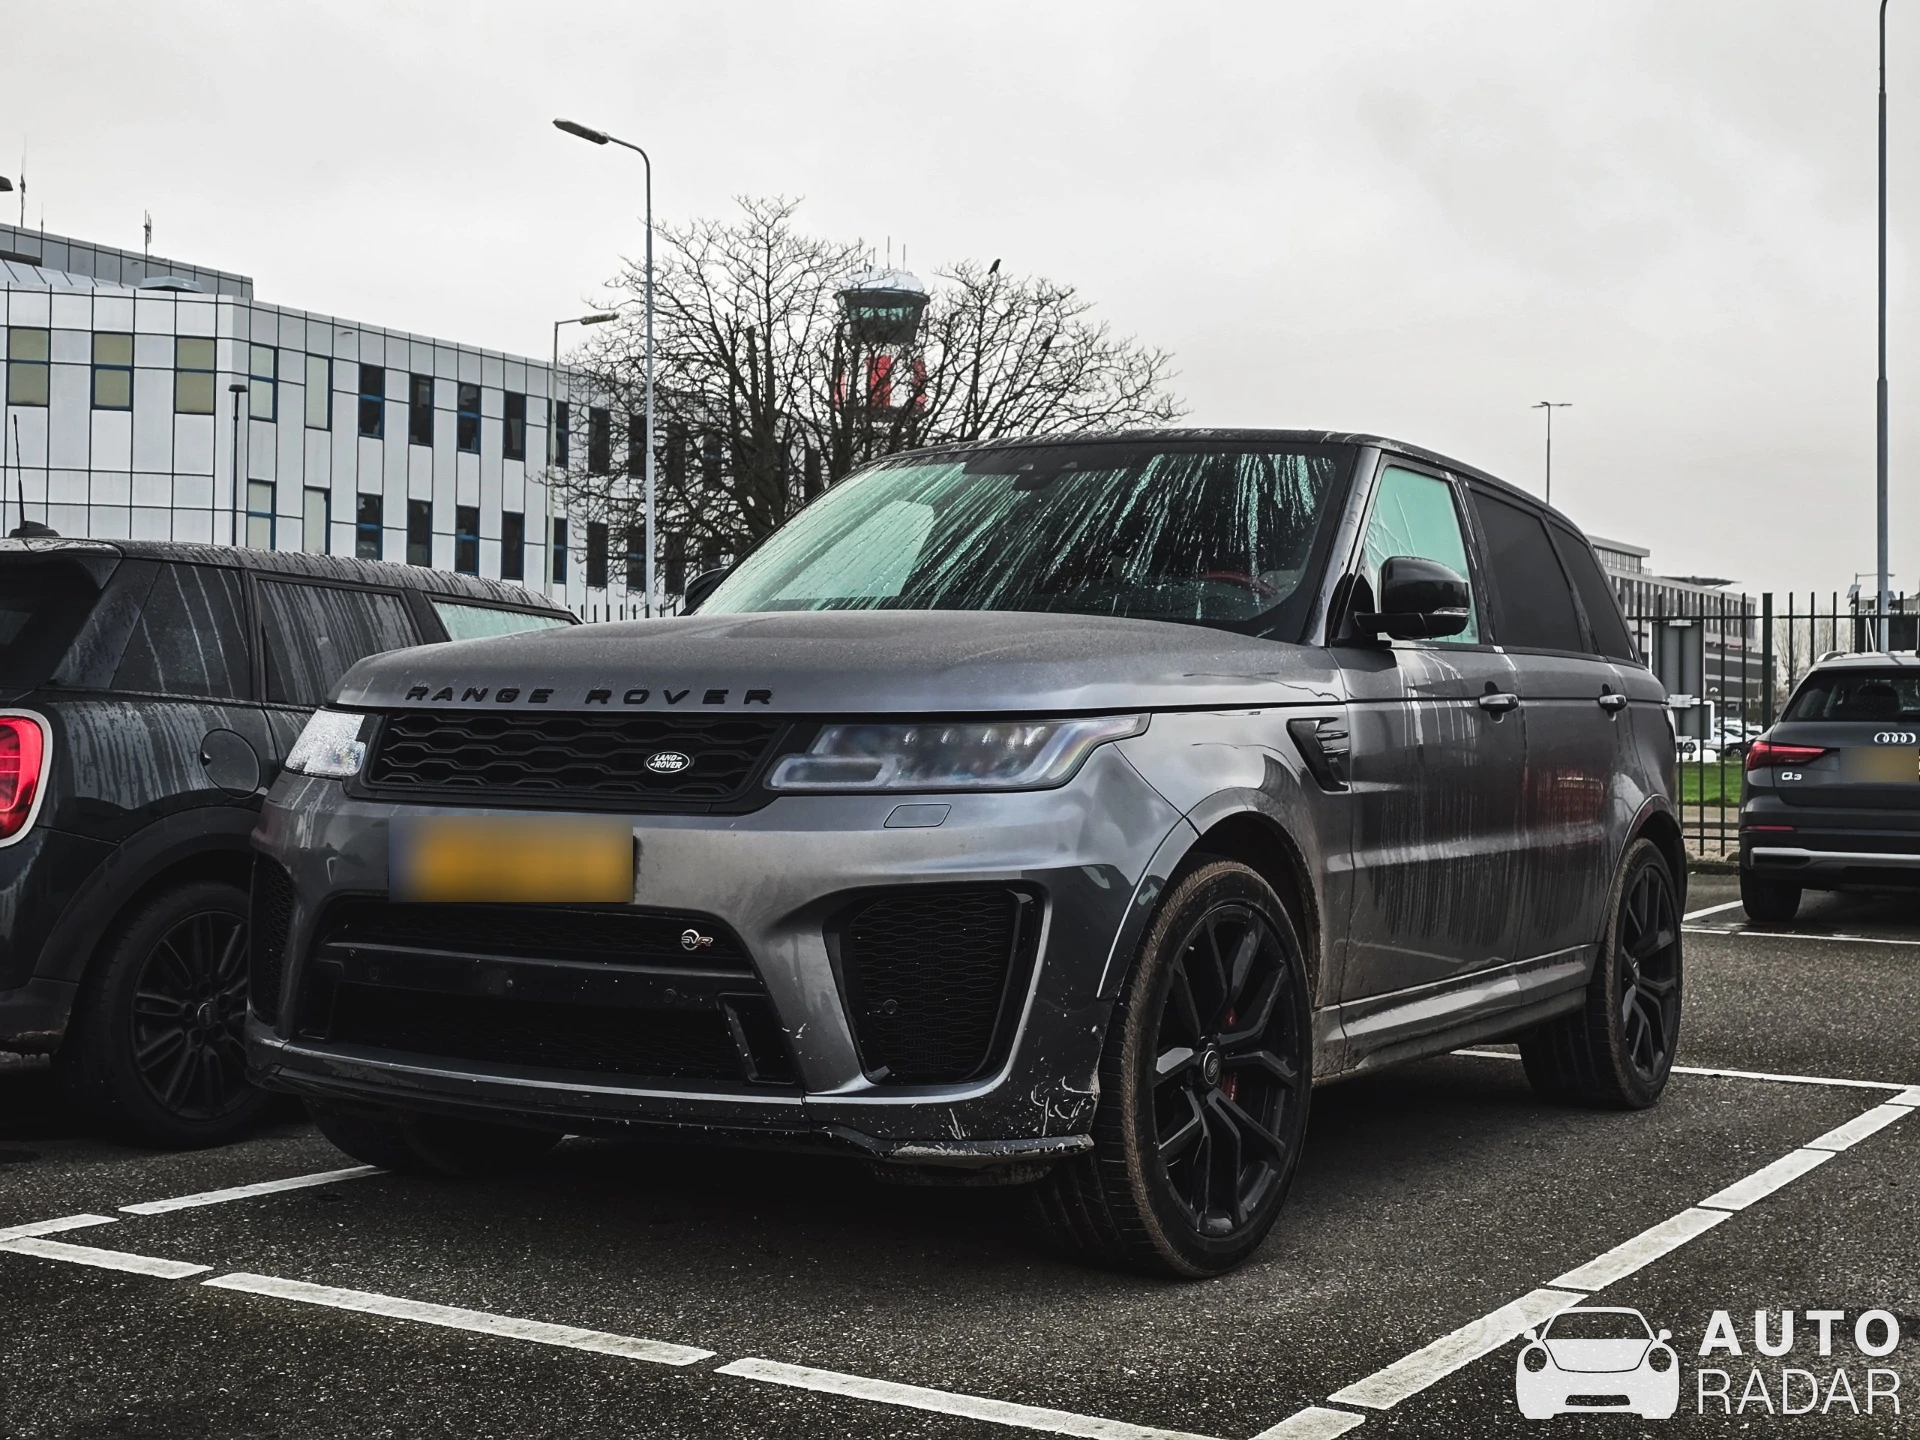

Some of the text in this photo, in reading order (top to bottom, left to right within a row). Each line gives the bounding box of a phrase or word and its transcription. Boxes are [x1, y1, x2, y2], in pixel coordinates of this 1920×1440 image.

[405, 686, 772, 705] RANGE ROVER
[1781, 771, 1802, 781] Q3
